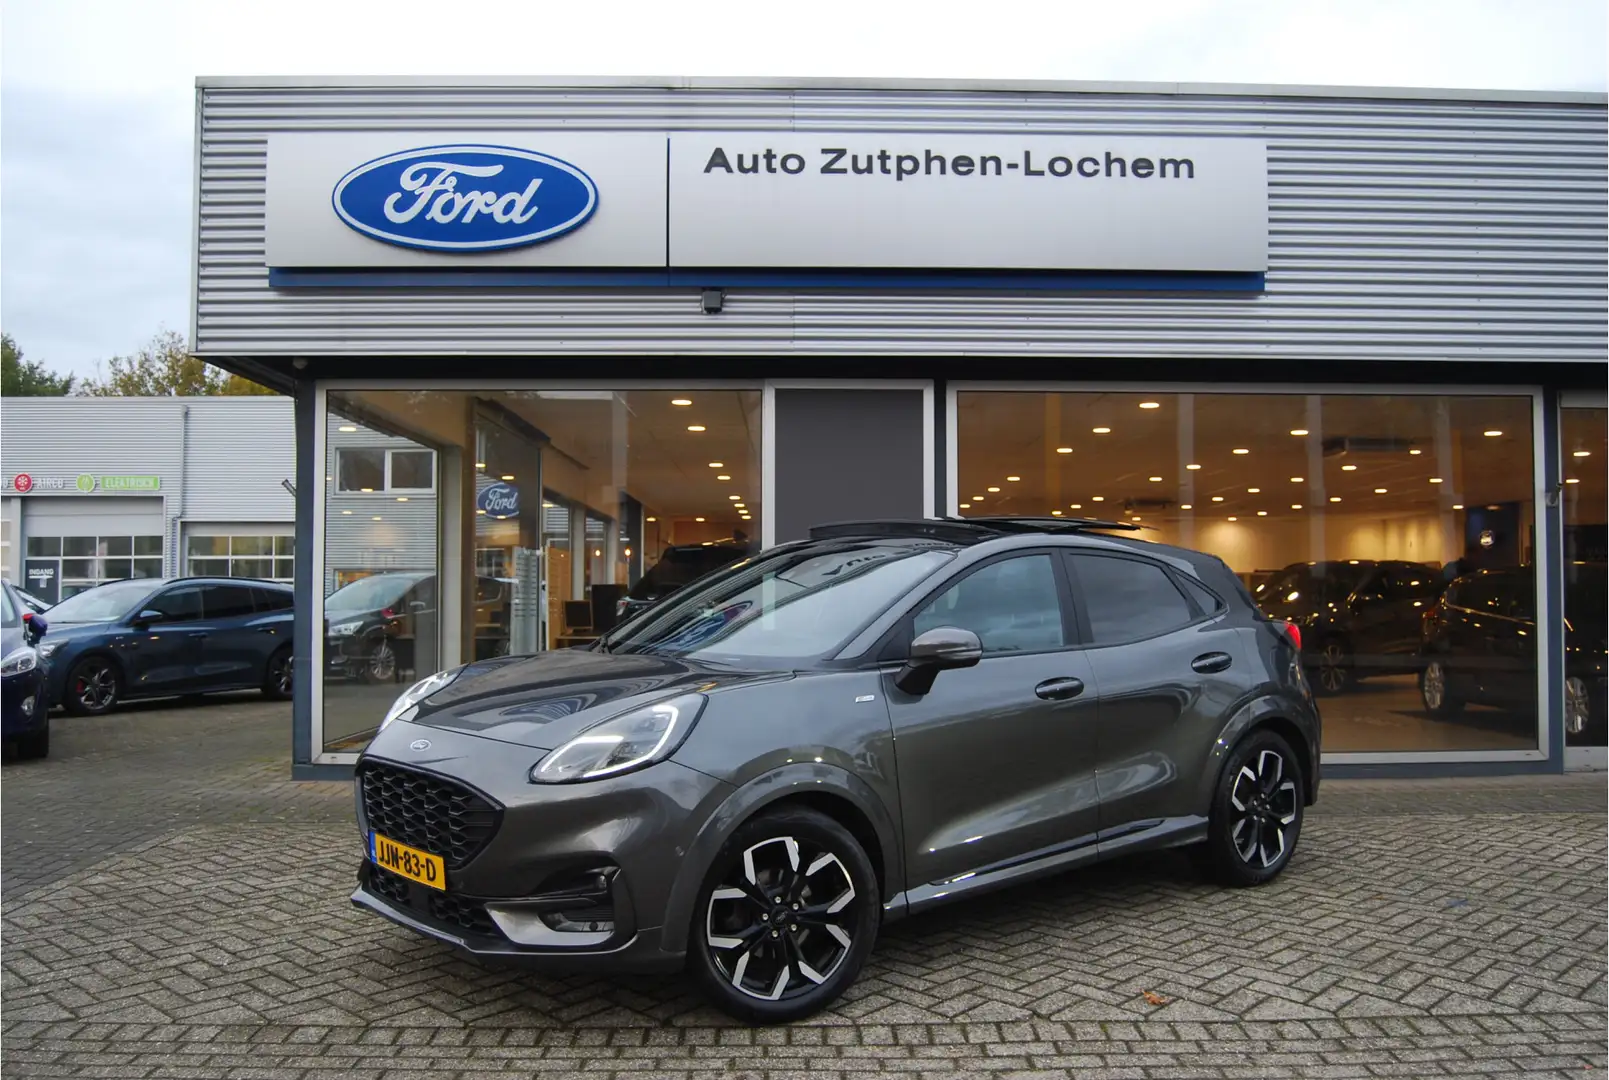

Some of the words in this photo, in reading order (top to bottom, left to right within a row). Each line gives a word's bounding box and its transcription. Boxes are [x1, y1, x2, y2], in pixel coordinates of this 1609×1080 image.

[704, 147, 806, 175] Auto
[820, 148, 1196, 182] Zutphen-Lochem
[383, 161, 543, 225] Ford
[485, 488, 518, 510] Ford
[379, 840, 437, 882] JJN-83-D
